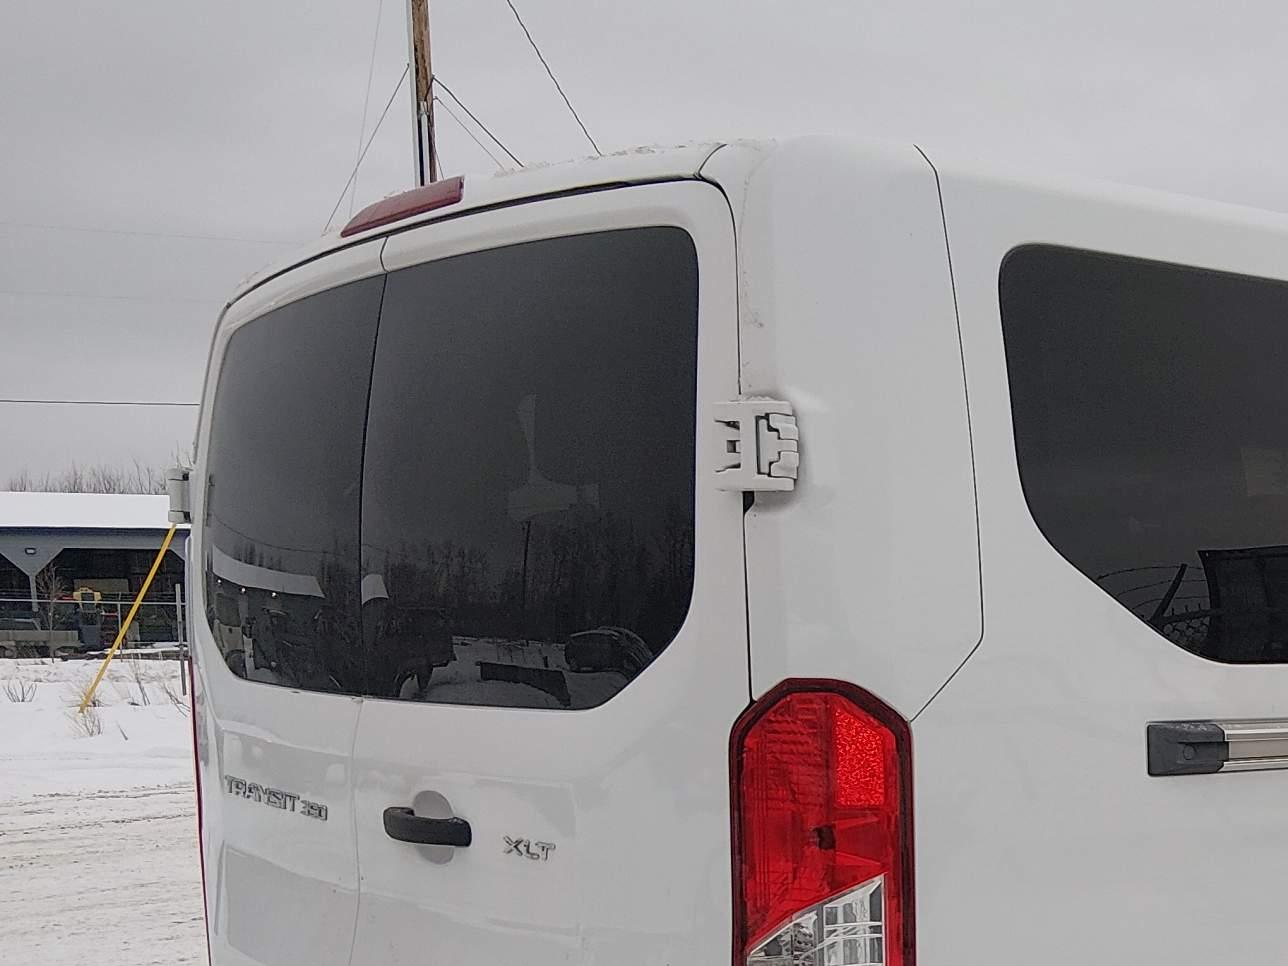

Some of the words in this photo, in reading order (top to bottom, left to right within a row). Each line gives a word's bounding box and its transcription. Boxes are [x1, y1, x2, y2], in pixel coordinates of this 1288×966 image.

[225, 775, 301, 812] TRANSIT
[299, 800, 328, 821] 350
[503, 836, 556, 862] XLT
